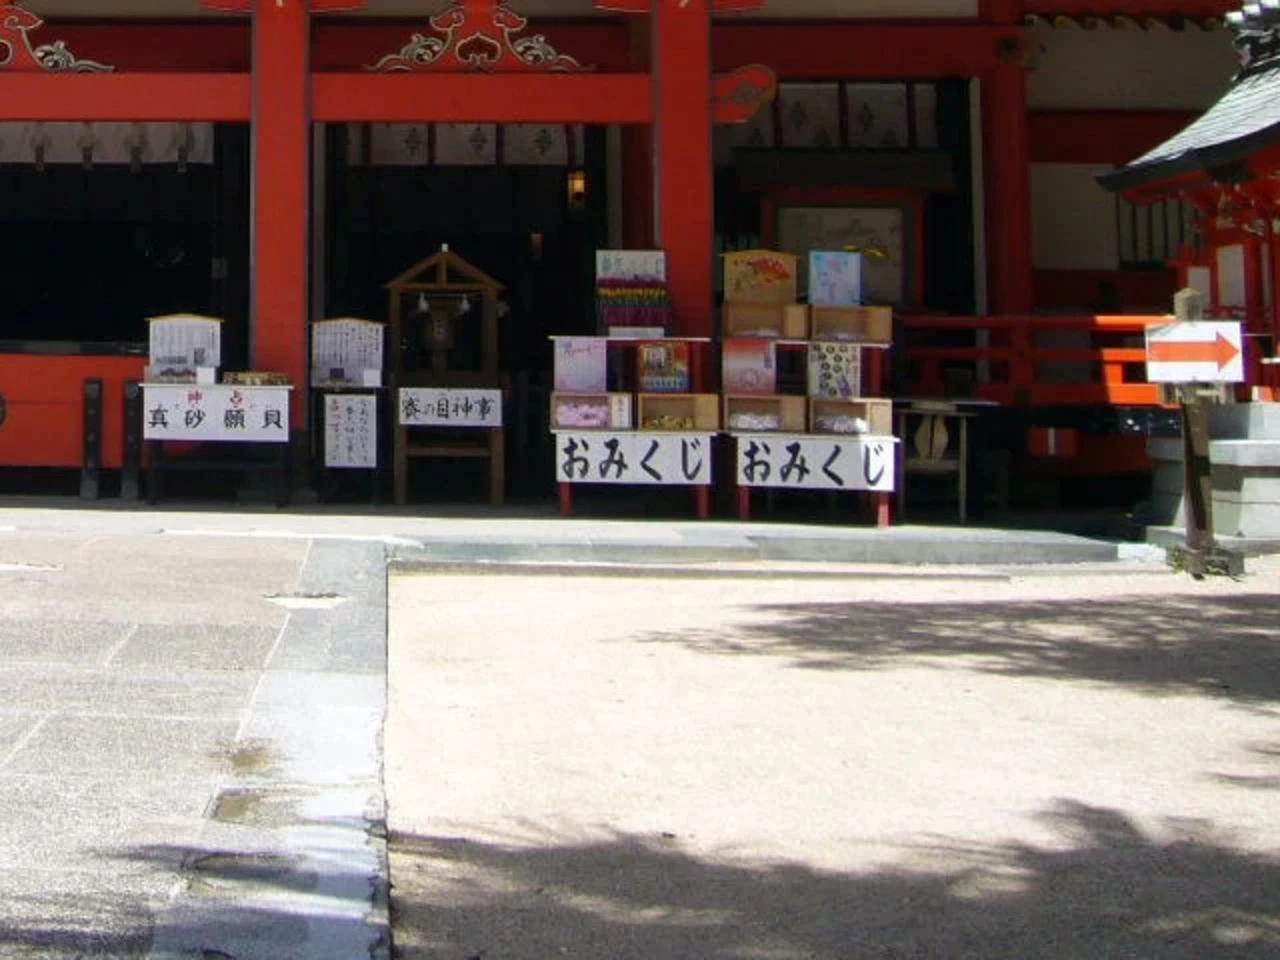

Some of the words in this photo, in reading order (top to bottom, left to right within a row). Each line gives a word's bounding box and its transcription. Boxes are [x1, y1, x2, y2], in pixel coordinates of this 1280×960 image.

[147, 402, 283, 429] 真砂願貝
[562, 437, 702, 481] おみくじ
[743, 440, 885, 487] おみくじ
